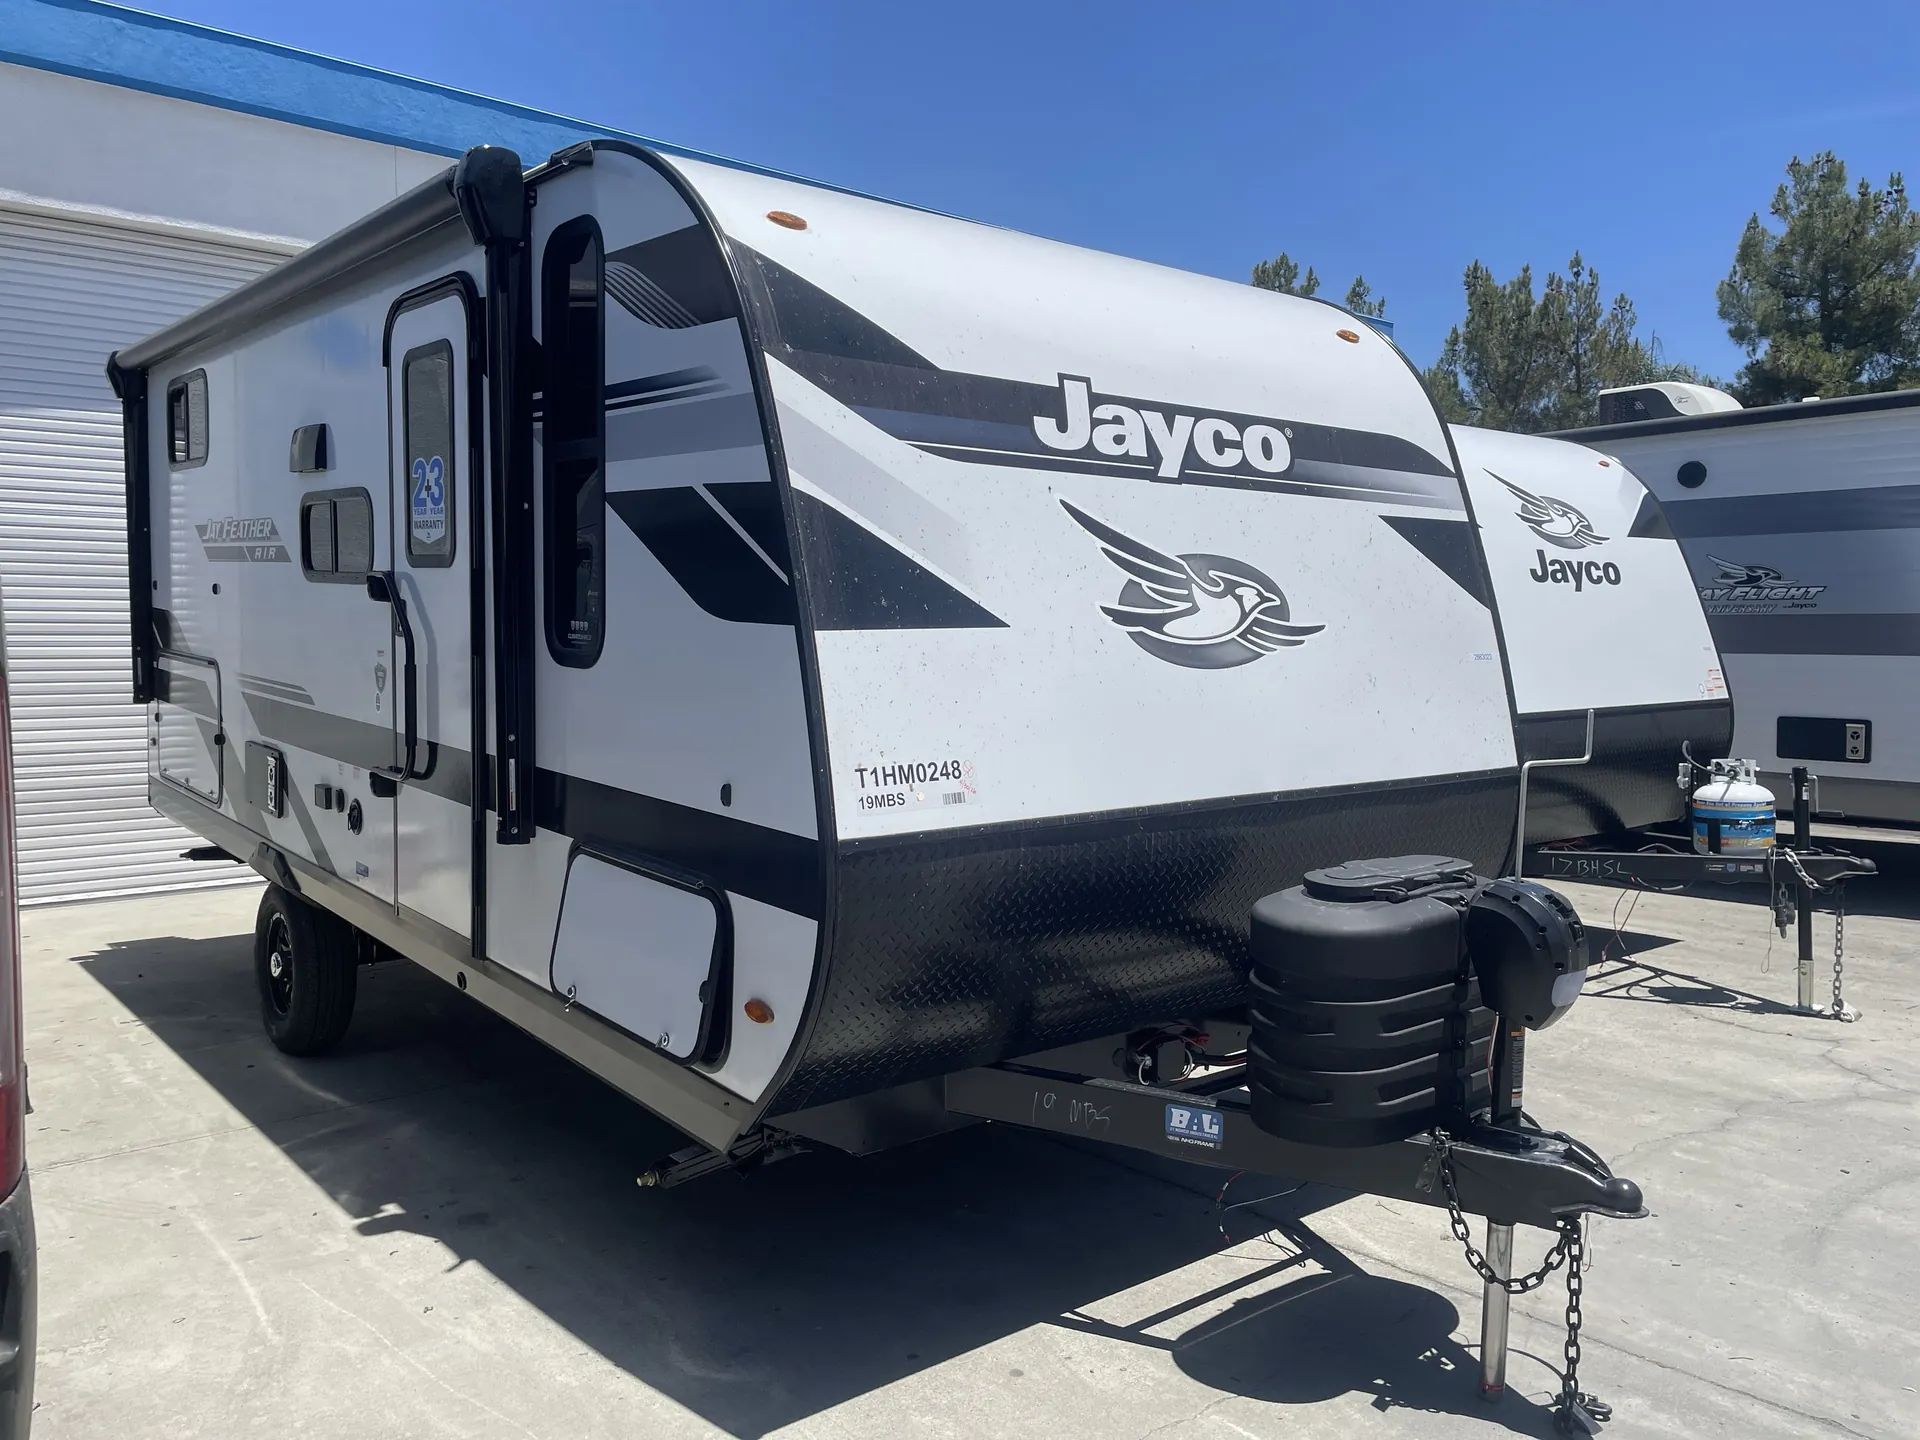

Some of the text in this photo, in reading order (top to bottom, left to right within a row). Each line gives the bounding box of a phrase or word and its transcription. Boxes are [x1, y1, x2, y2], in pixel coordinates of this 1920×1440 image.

[1033, 379, 1292, 479] Jayco
[413, 506, 444, 516] YEAR YEAR
[413, 519, 444, 530] WARRANTY
[254, 547, 276, 560] AIR
[1529, 549, 1621, 592] Jayco
[1699, 586, 1827, 601] AY FLIGHT
[855, 760, 962, 789] T1HM0248
[858, 792, 906, 810] 19MBS
